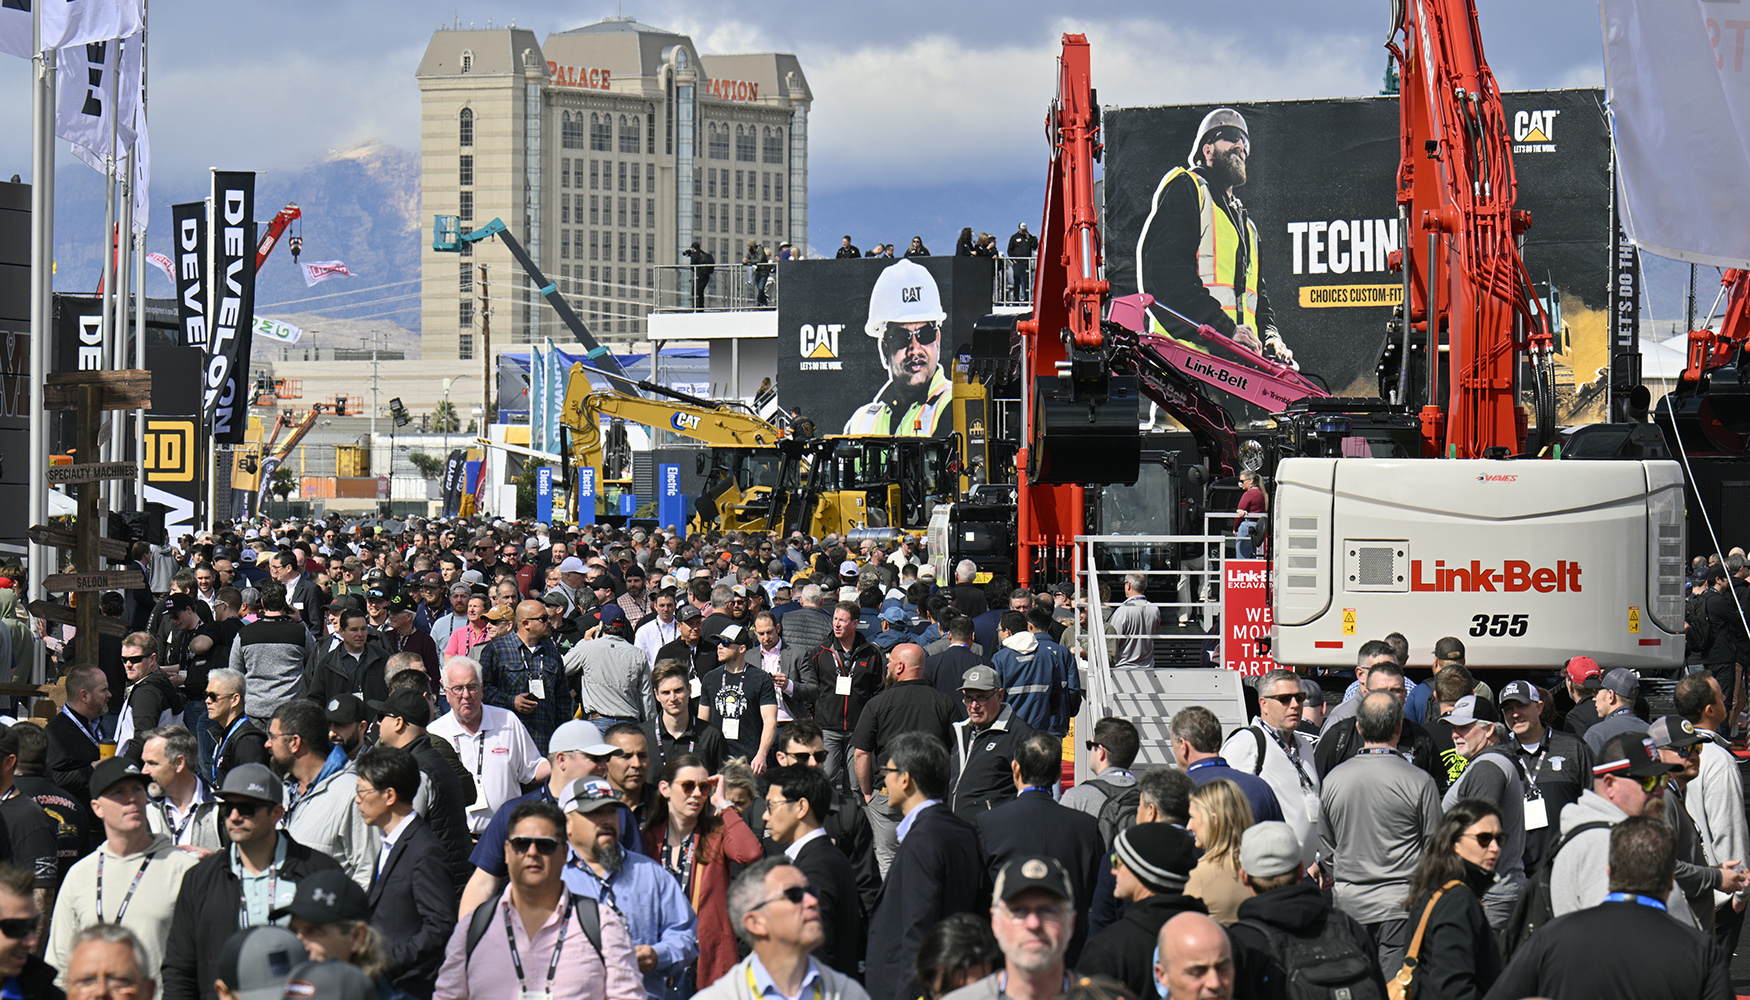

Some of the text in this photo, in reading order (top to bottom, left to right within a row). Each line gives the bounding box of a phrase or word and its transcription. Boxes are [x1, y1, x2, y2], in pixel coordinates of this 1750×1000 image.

[547, 61, 611, 90] PALACE
[1514, 110, 1556, 142] CAT
[181, 218, 207, 352] DEVE
[902, 286, 922, 303] CAT
[1310, 287, 1402, 303] CHOICES CUSTOM-FIT
[1619, 273, 1632, 298] DO
[1619, 300, 1632, 346] LET'S
[800, 323, 842, 359] CAT
[1184, 356, 1248, 391] Link-Belt
[676, 412, 701, 430] CAT
[49, 463, 136, 481] SPECIALTY MACHINES
[539, 469, 550, 496] Electric
[582, 469, 594, 497] Electric
[667, 466, 679, 497] Electric
[76, 576, 109, 588] SALOON
[1227, 569, 1273, 582] Link-B
[1411, 559, 1583, 593] Link-Belt
[1246, 607, 1272, 622] WE
[1468, 614, 1529, 638] 355
